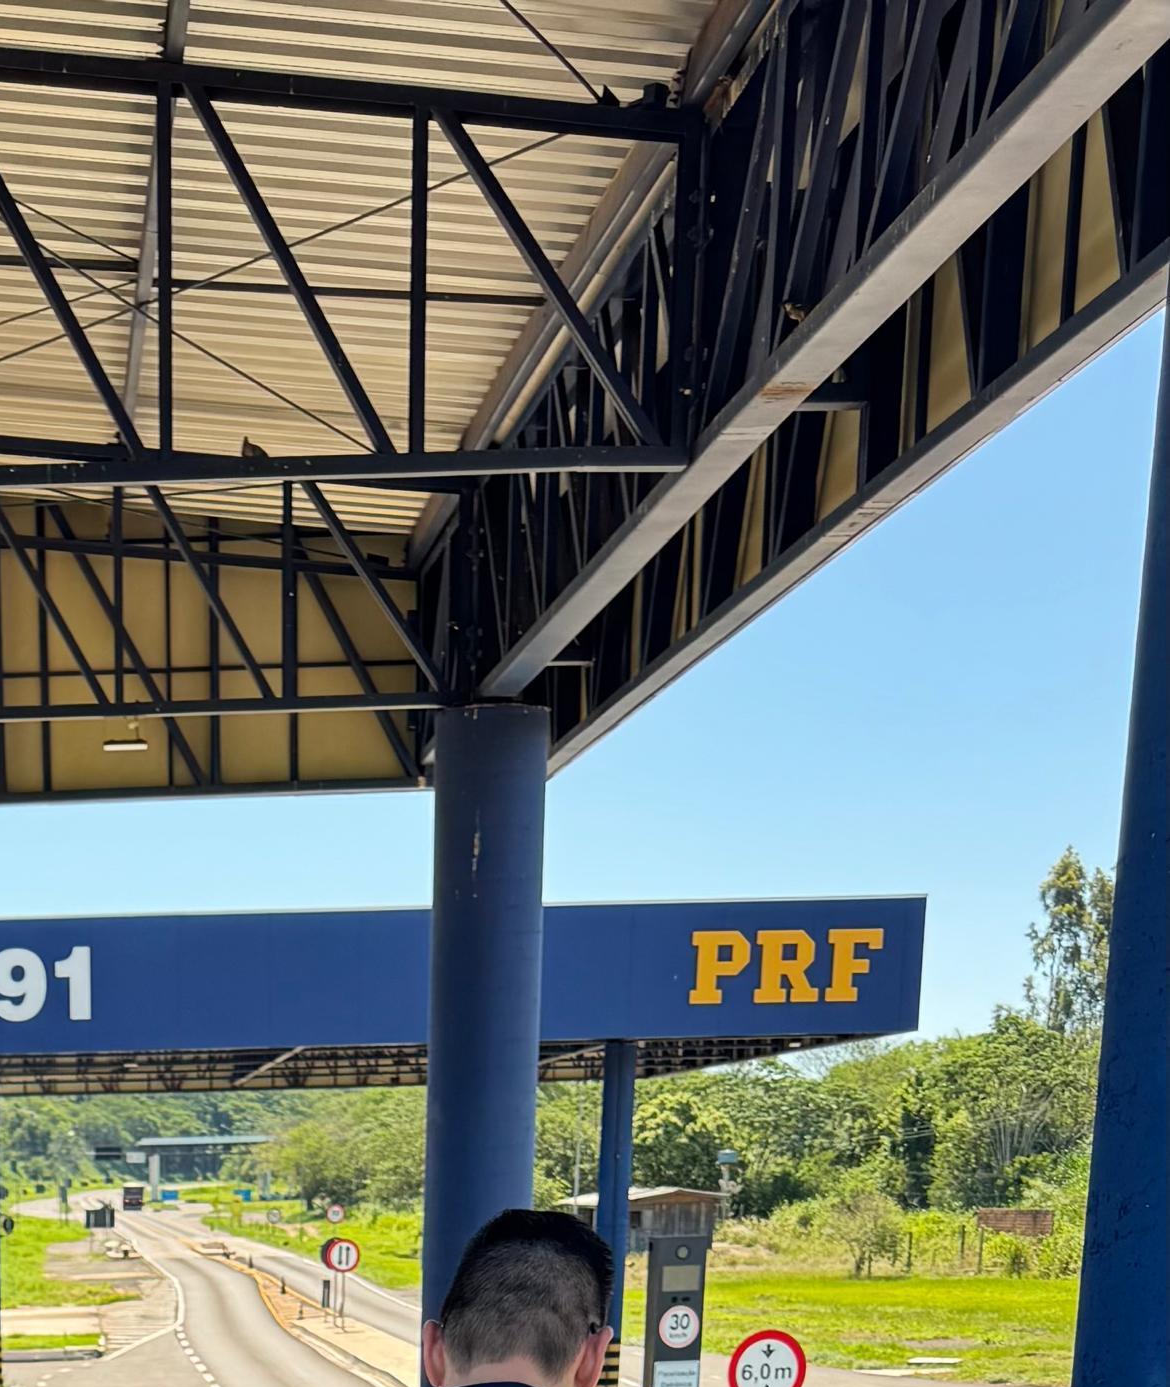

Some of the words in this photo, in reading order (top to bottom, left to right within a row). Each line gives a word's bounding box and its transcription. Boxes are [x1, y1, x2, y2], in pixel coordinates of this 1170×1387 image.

[689, 928, 884, 1004] PRF
[670, 1313, 690, 1330] 30
[741, 1363, 770, 1383] 6,0
[774, 1366, 792, 1379] m
